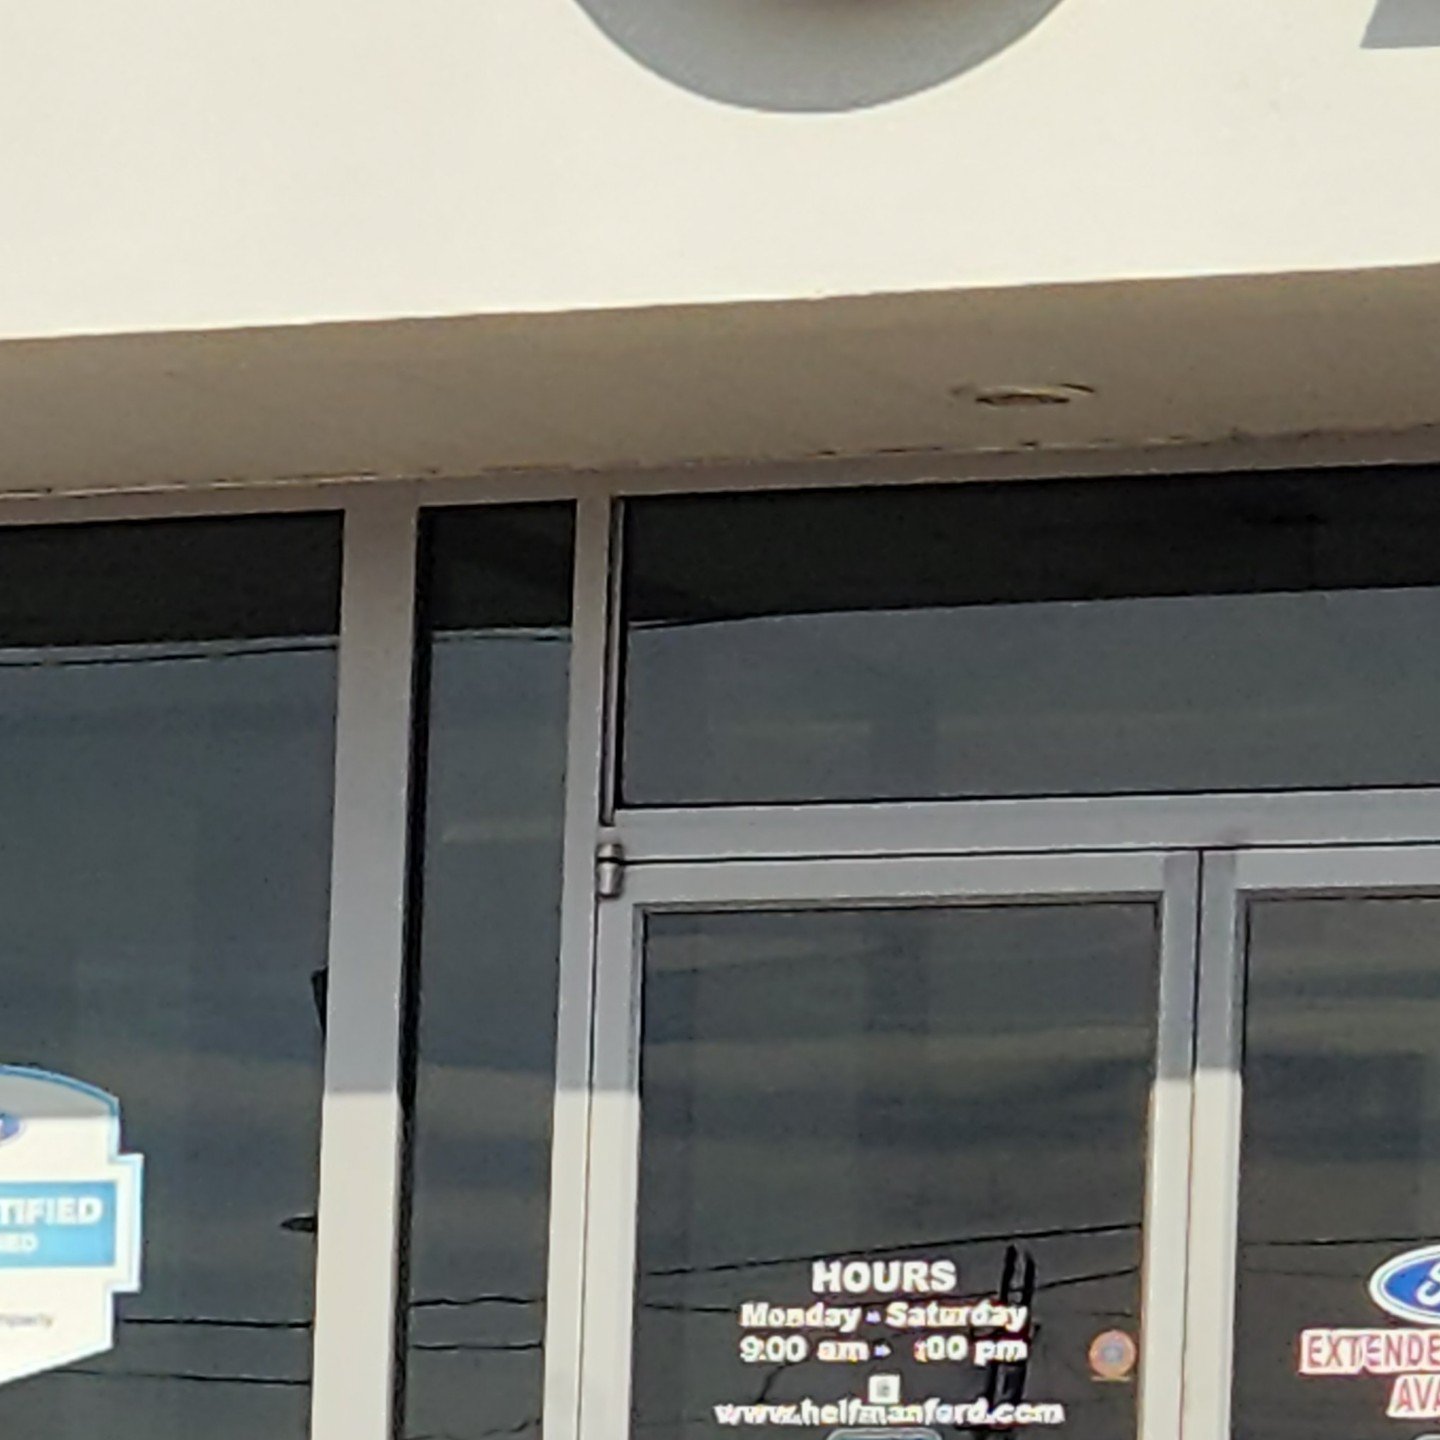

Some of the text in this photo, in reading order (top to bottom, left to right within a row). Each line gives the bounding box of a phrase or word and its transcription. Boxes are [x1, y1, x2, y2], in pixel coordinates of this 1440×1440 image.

[812, 1260, 958, 1293] HOURS
[740, 1302, 863, 1332] Monday
[885, 1301, 1029, 1331] Saturday
[740, 1335, 808, 1362] 9:00
[817, 1339, 870, 1362] am
[973, 1339, 1028, 1366] pm
[714, 1398, 1066, 1425] www.helfmanford.com
